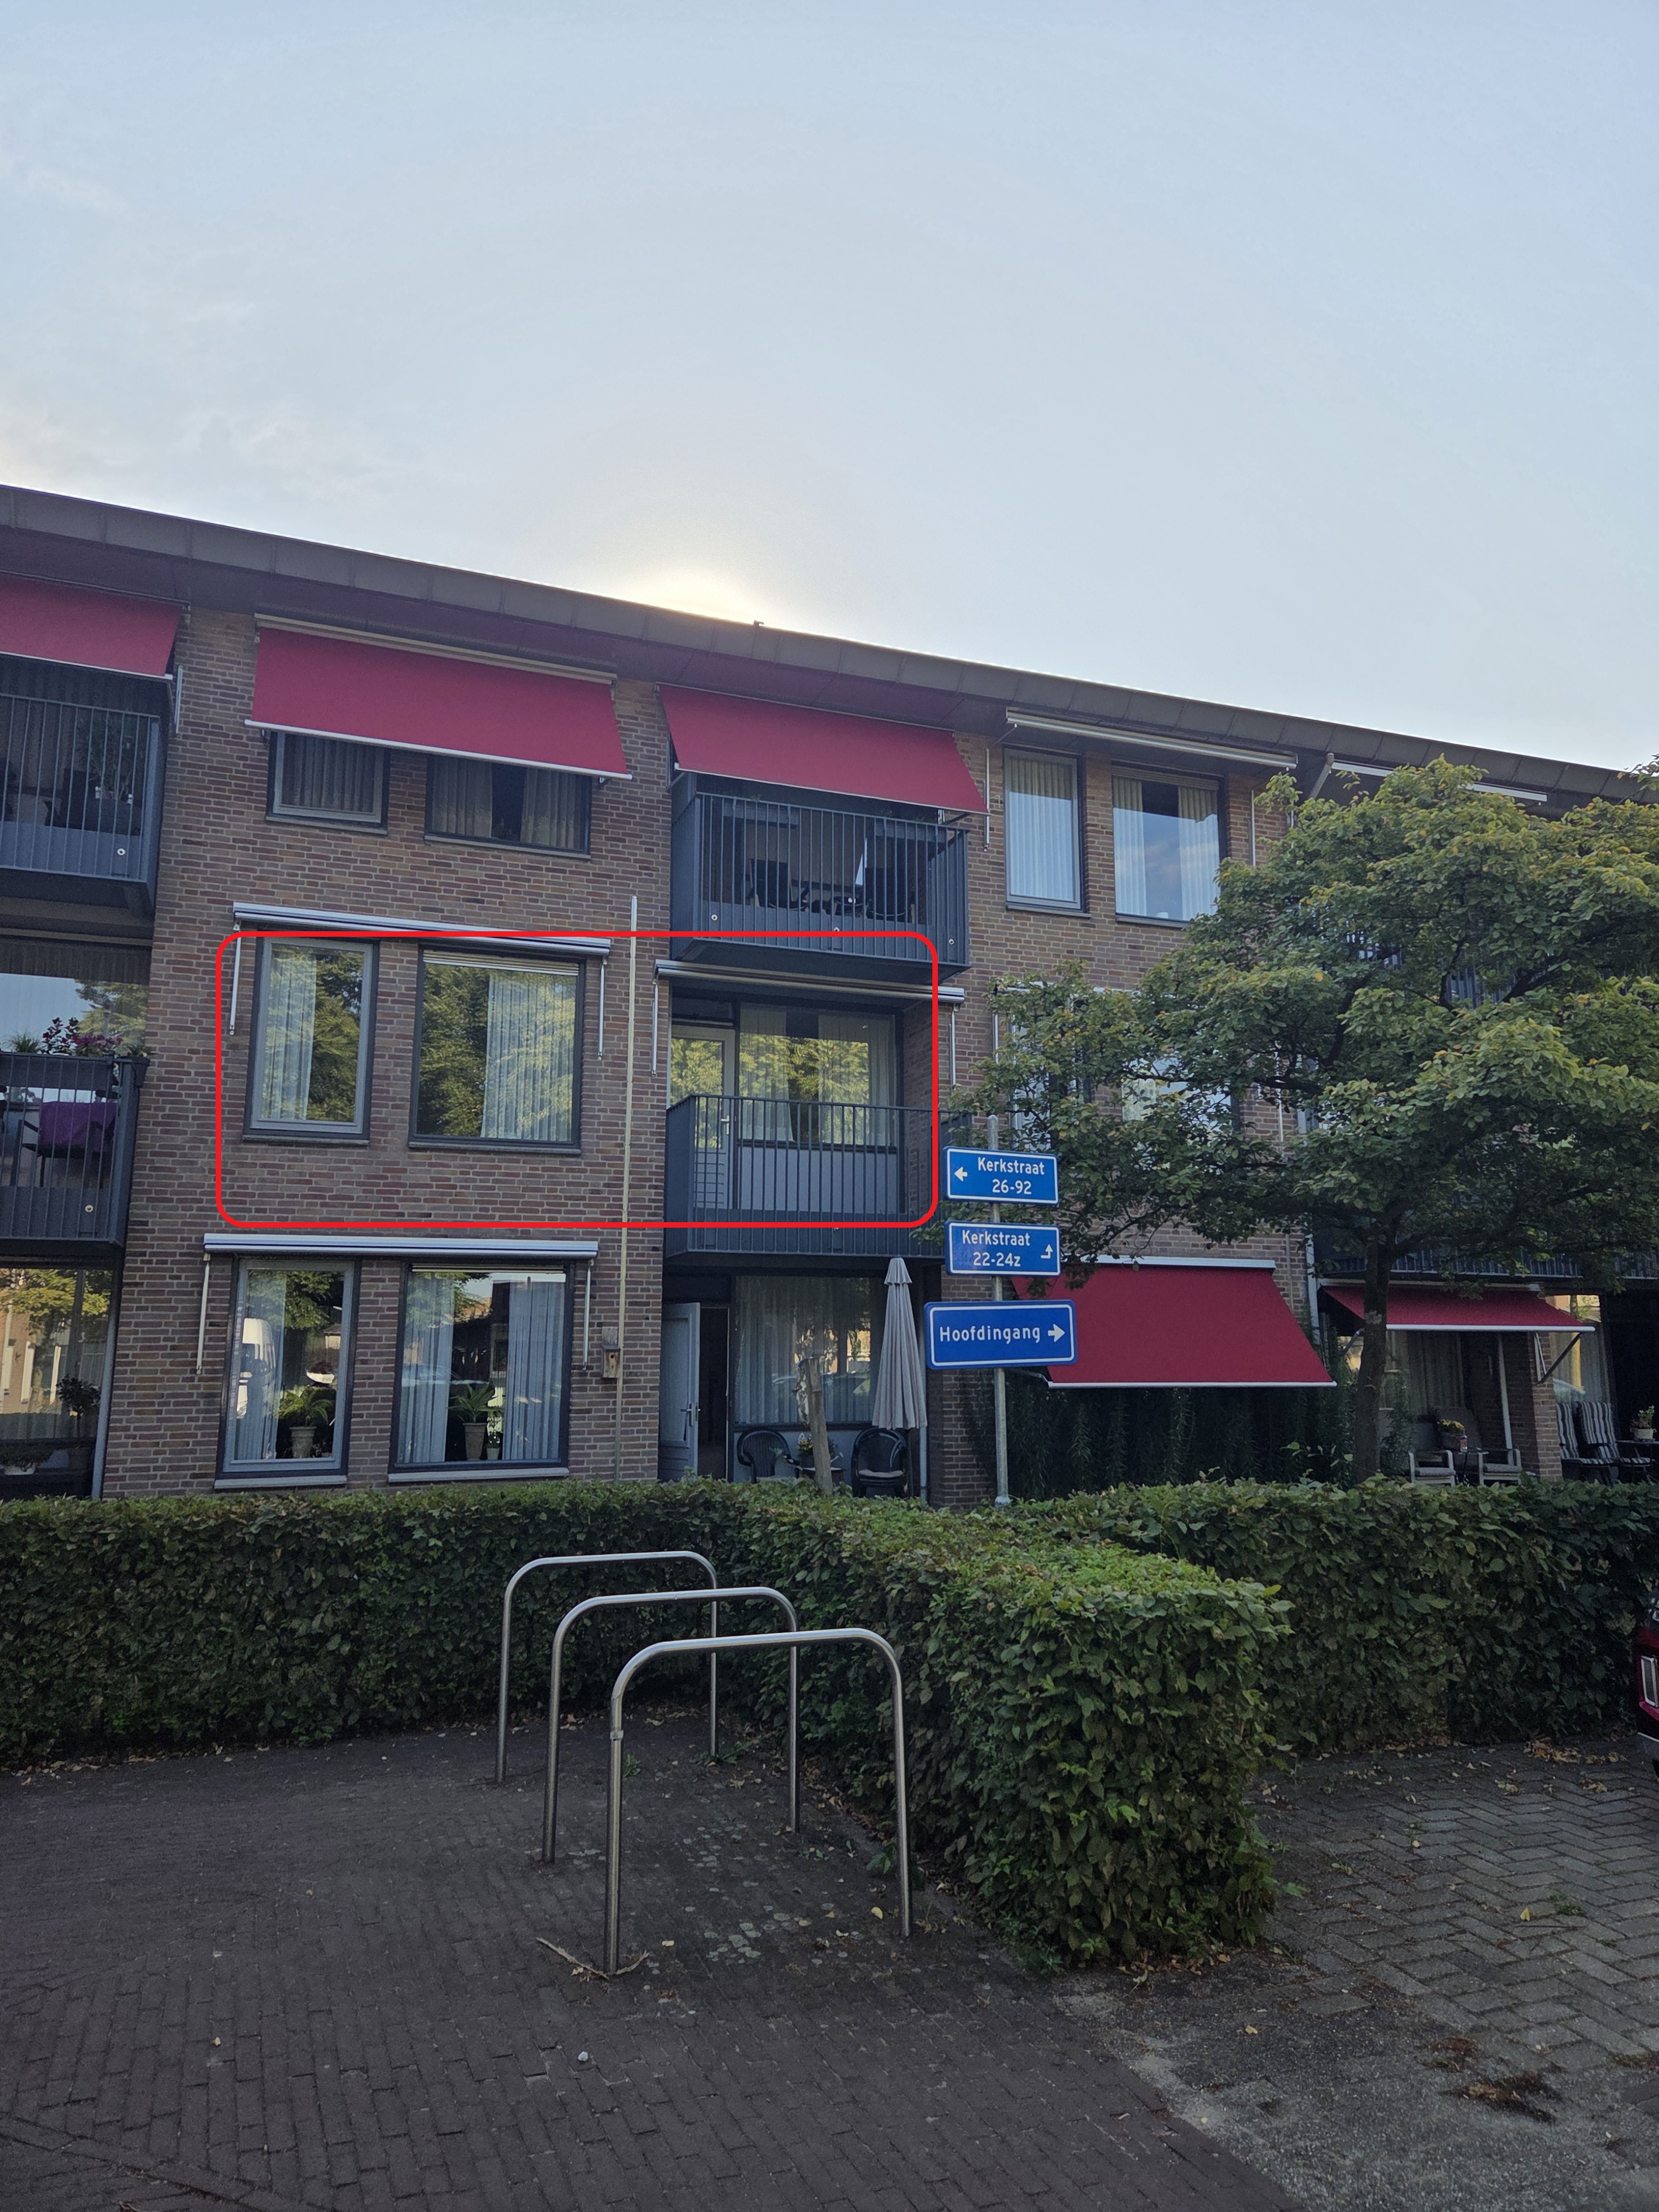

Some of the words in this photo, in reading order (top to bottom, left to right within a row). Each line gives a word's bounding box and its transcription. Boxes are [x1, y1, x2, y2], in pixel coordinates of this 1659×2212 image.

[978, 1157, 1045, 1175] Kerkstraat
[992, 1179, 1032, 1194] 26-92
[962, 1229, 1030, 1246] Kerkstraat
[973, 1251, 1021, 1267] 22-24z
[940, 1325, 1041, 1344] Hoofdingang
